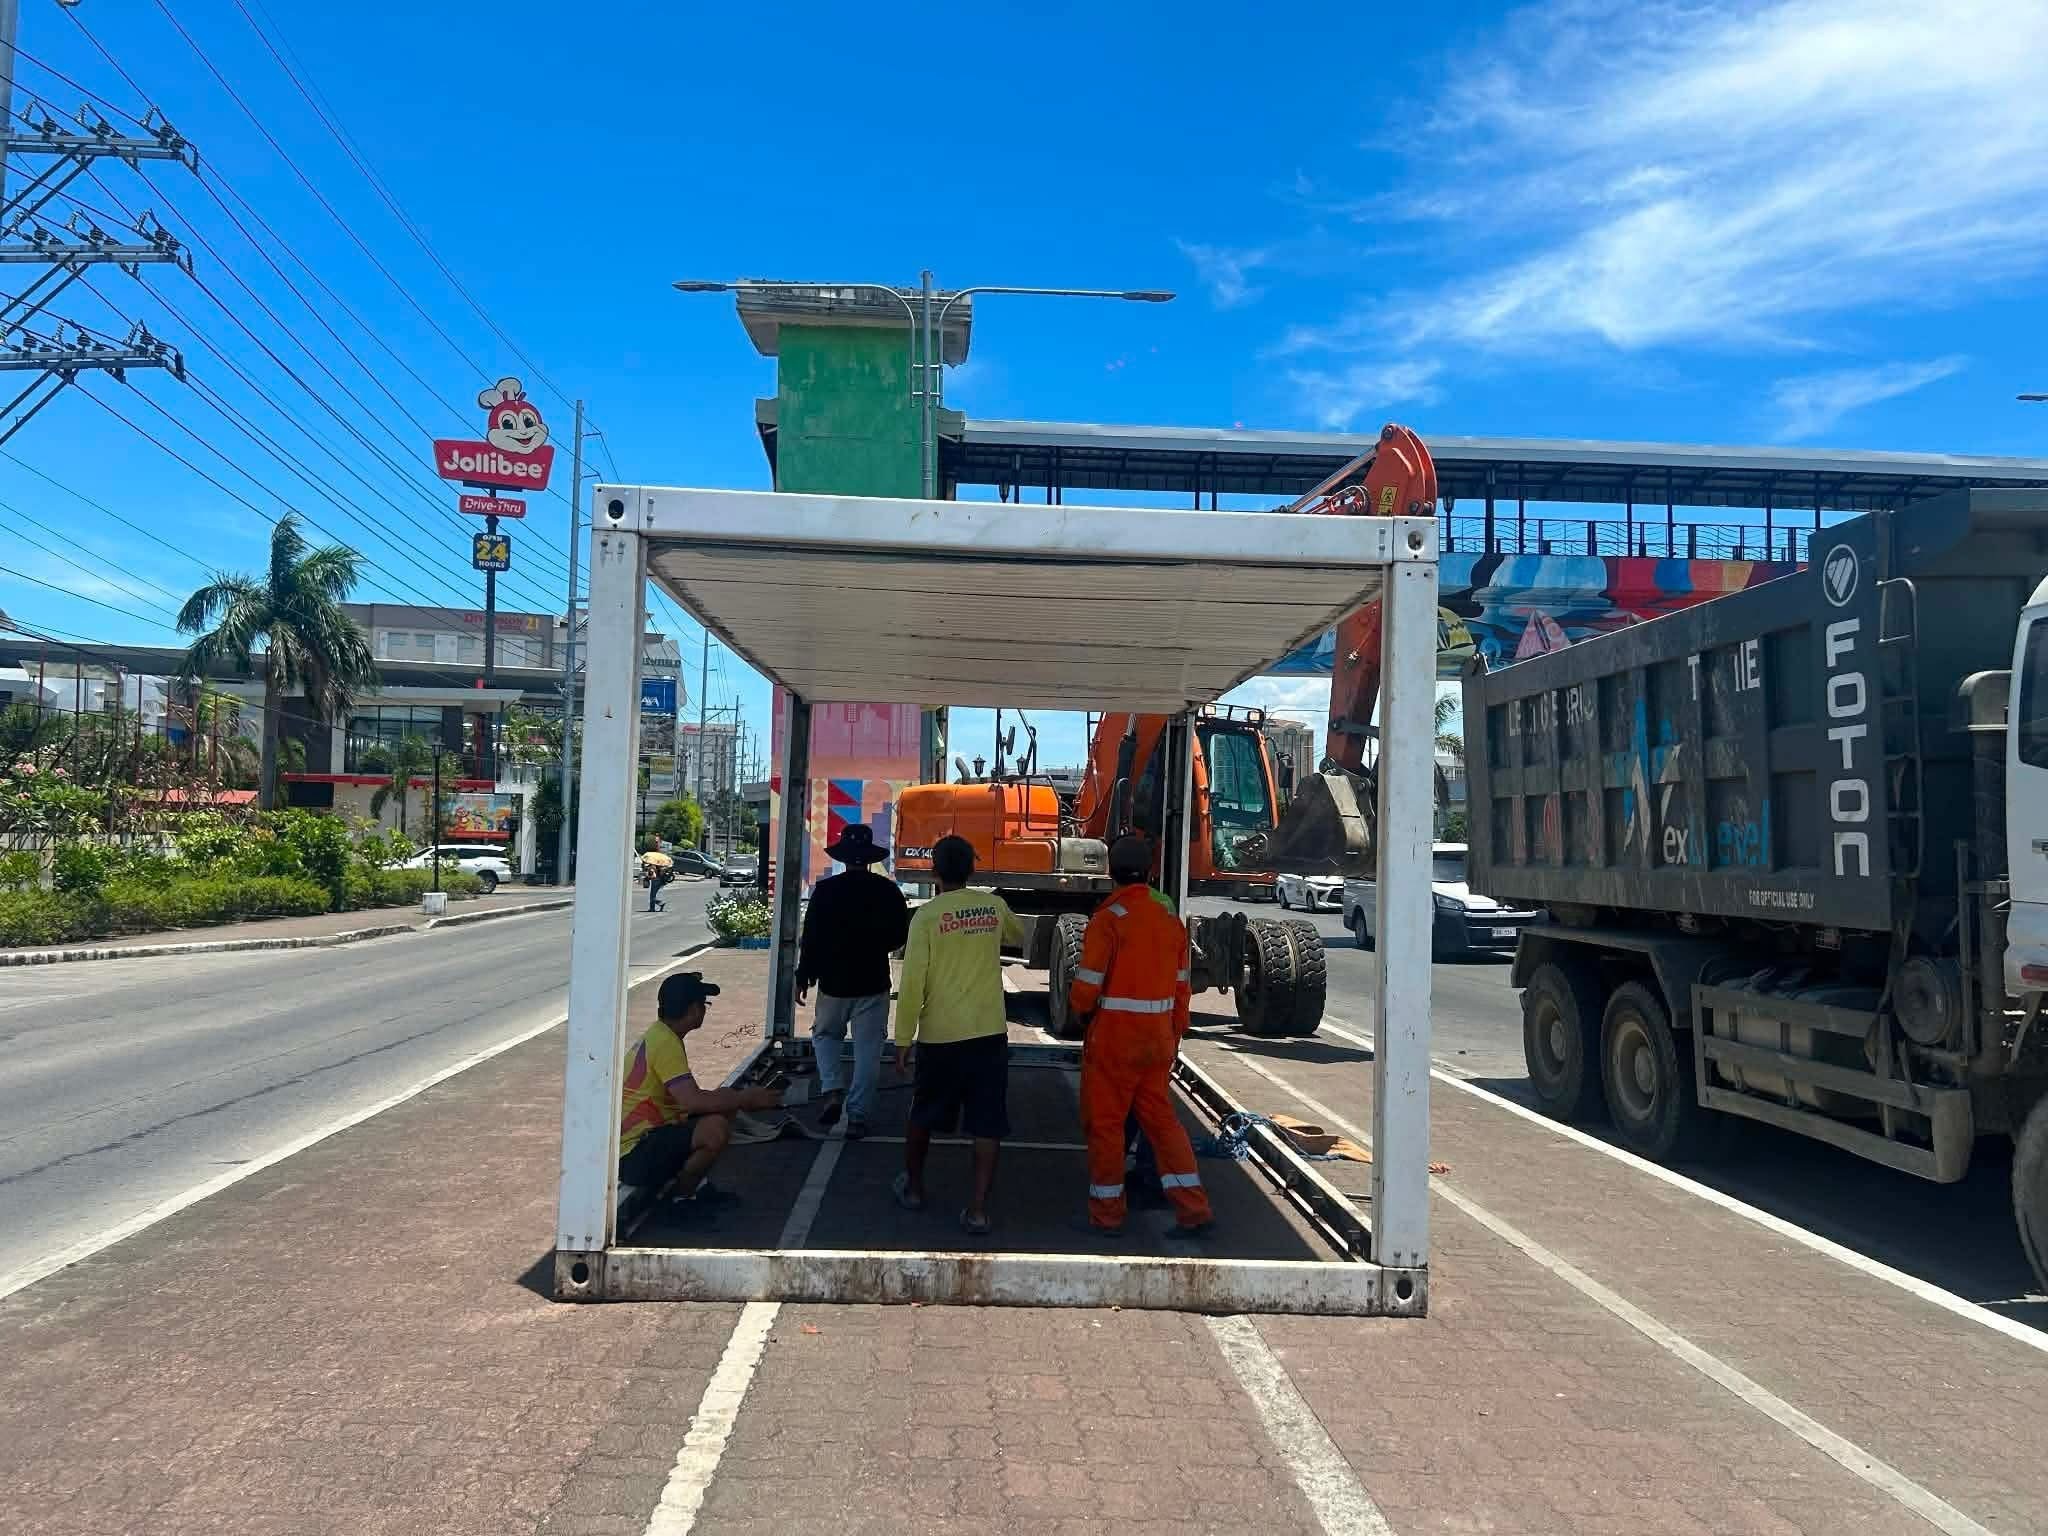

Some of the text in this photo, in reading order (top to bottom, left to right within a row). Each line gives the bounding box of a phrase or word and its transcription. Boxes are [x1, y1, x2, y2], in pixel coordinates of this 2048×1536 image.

[443, 449, 543, 479] Jollibee
[464, 498, 522, 513] Drive-Thru
[476, 540, 509, 562] 24
[478, 560, 506, 569] HOURS
[955, 906, 996, 919] USWAG
